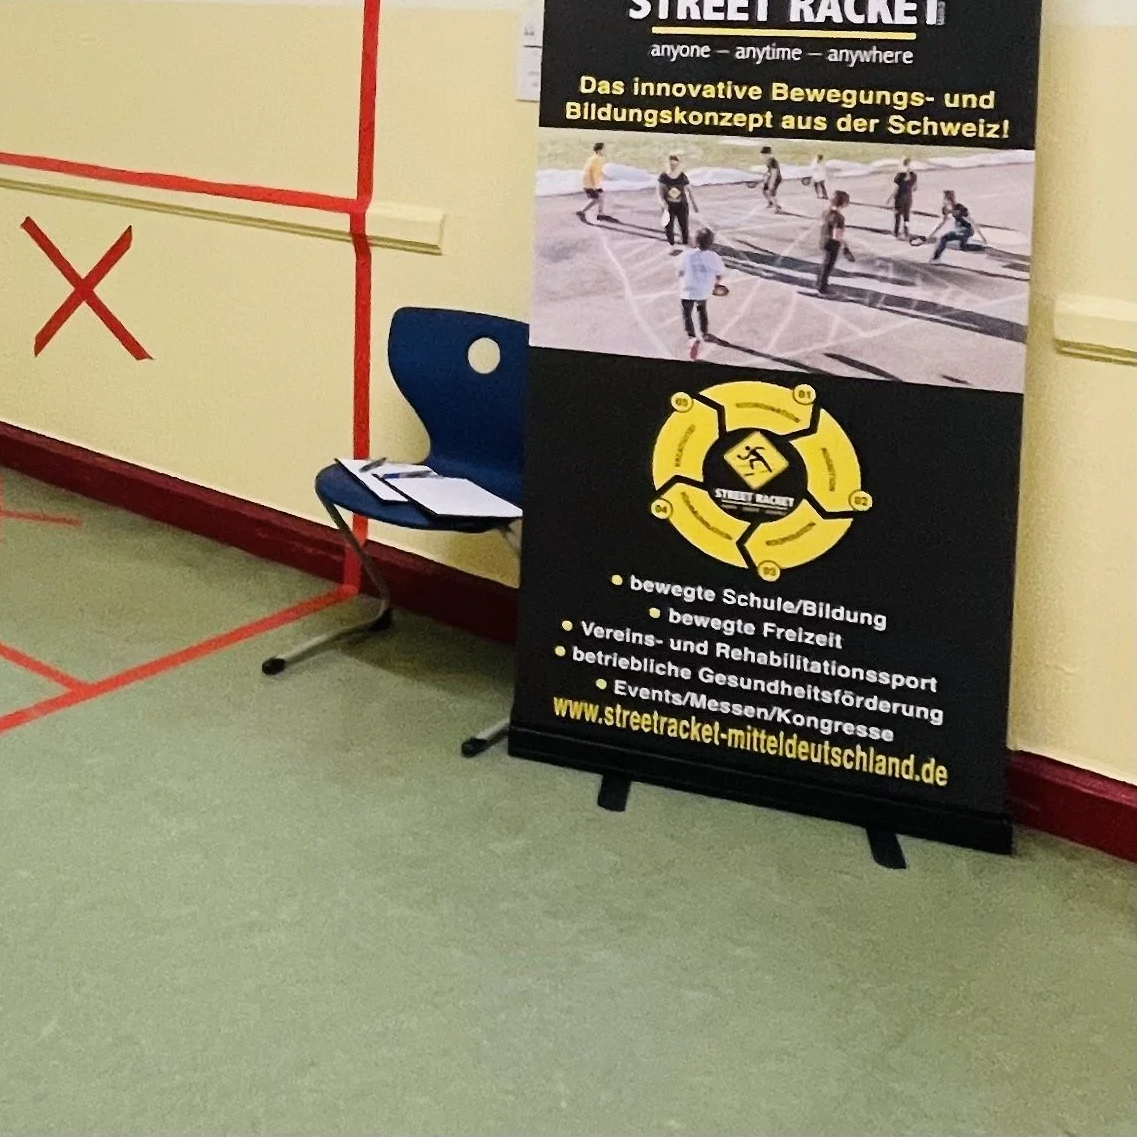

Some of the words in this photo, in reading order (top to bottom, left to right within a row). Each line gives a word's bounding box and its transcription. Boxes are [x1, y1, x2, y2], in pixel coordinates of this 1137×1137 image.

[651, 44, 710, 61] anyone
[735, 43, 802, 64] anytime
[828, 46, 913, 67] anywhere
[566, 102, 773, 132] Bildungskonzept
[782, 115, 827, 130] aus
[837, 114, 879, 132] der
[888, 115, 1009, 138] Schweiz!
[580, 76, 624, 94] Das
[634, 77, 762, 100] innovative
[772, 84, 934, 110] Bewegungs-
[945, 92, 995, 109] und
[631, 575, 715, 602] bewegte
[723, 589, 886, 631] Schule/Bildung
[669, 608, 755, 635] bewegte
[763, 622, 842, 649] Freizeit
[582, 621, 663, 646] Vereins-
[670, 638, 708, 655] und
[716, 643, 937, 692] Rehabilitationssport
[573, 646, 691, 679] betriebliche
[698, 667, 943, 725] Gesundheitsförderung
[614, 680, 893, 741] Events/Messen/Kongresse
[554, 697, 947, 786] www.streetracket-mitteldeutschland.de
